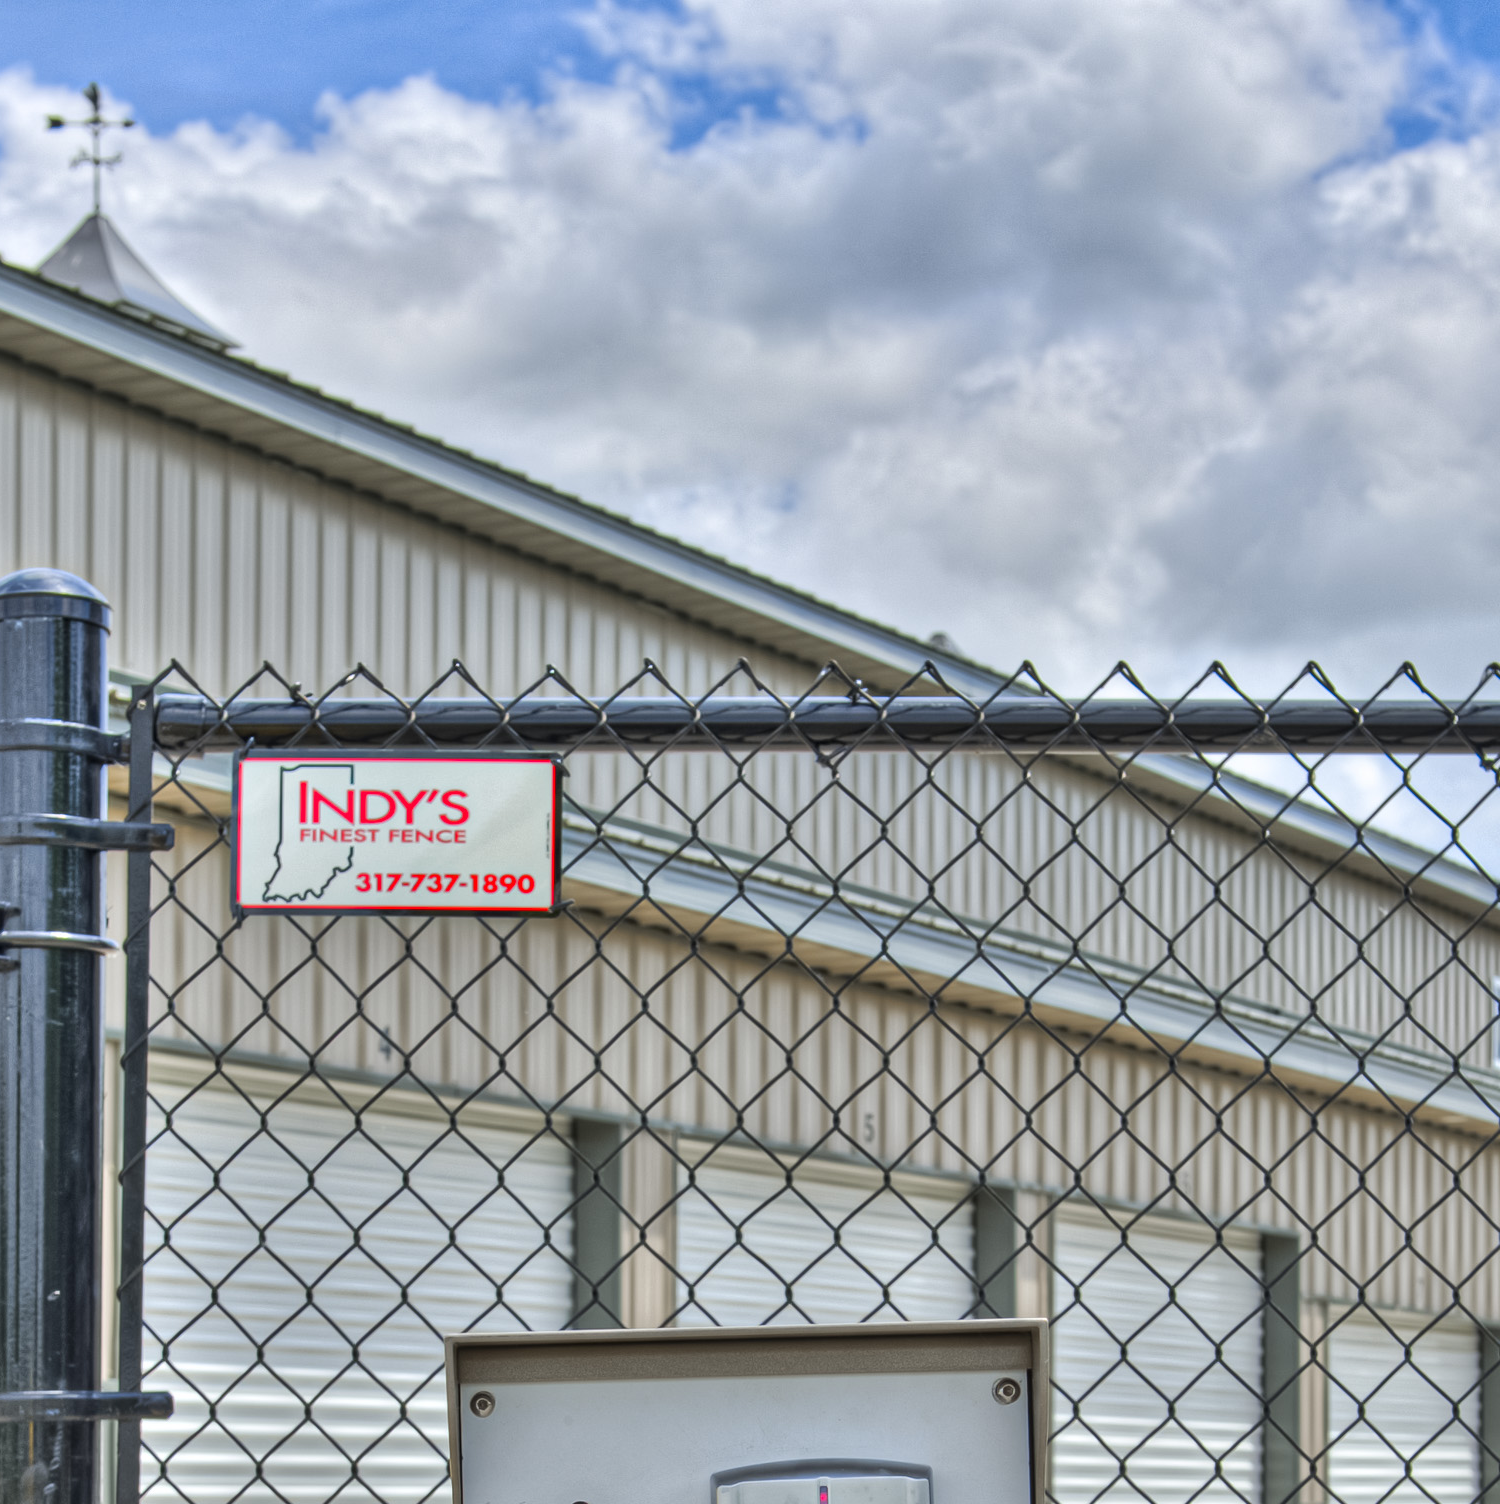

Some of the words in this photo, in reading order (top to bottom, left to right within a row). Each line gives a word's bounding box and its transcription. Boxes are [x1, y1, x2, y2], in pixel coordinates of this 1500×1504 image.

[299, 780, 470, 826] INDY'S
[299, 828, 381, 843] FINEST
[388, 829, 466, 844] FENCE
[355, 872, 536, 895] 317-737-1890
[863, 1112, 876, 1143] 5
